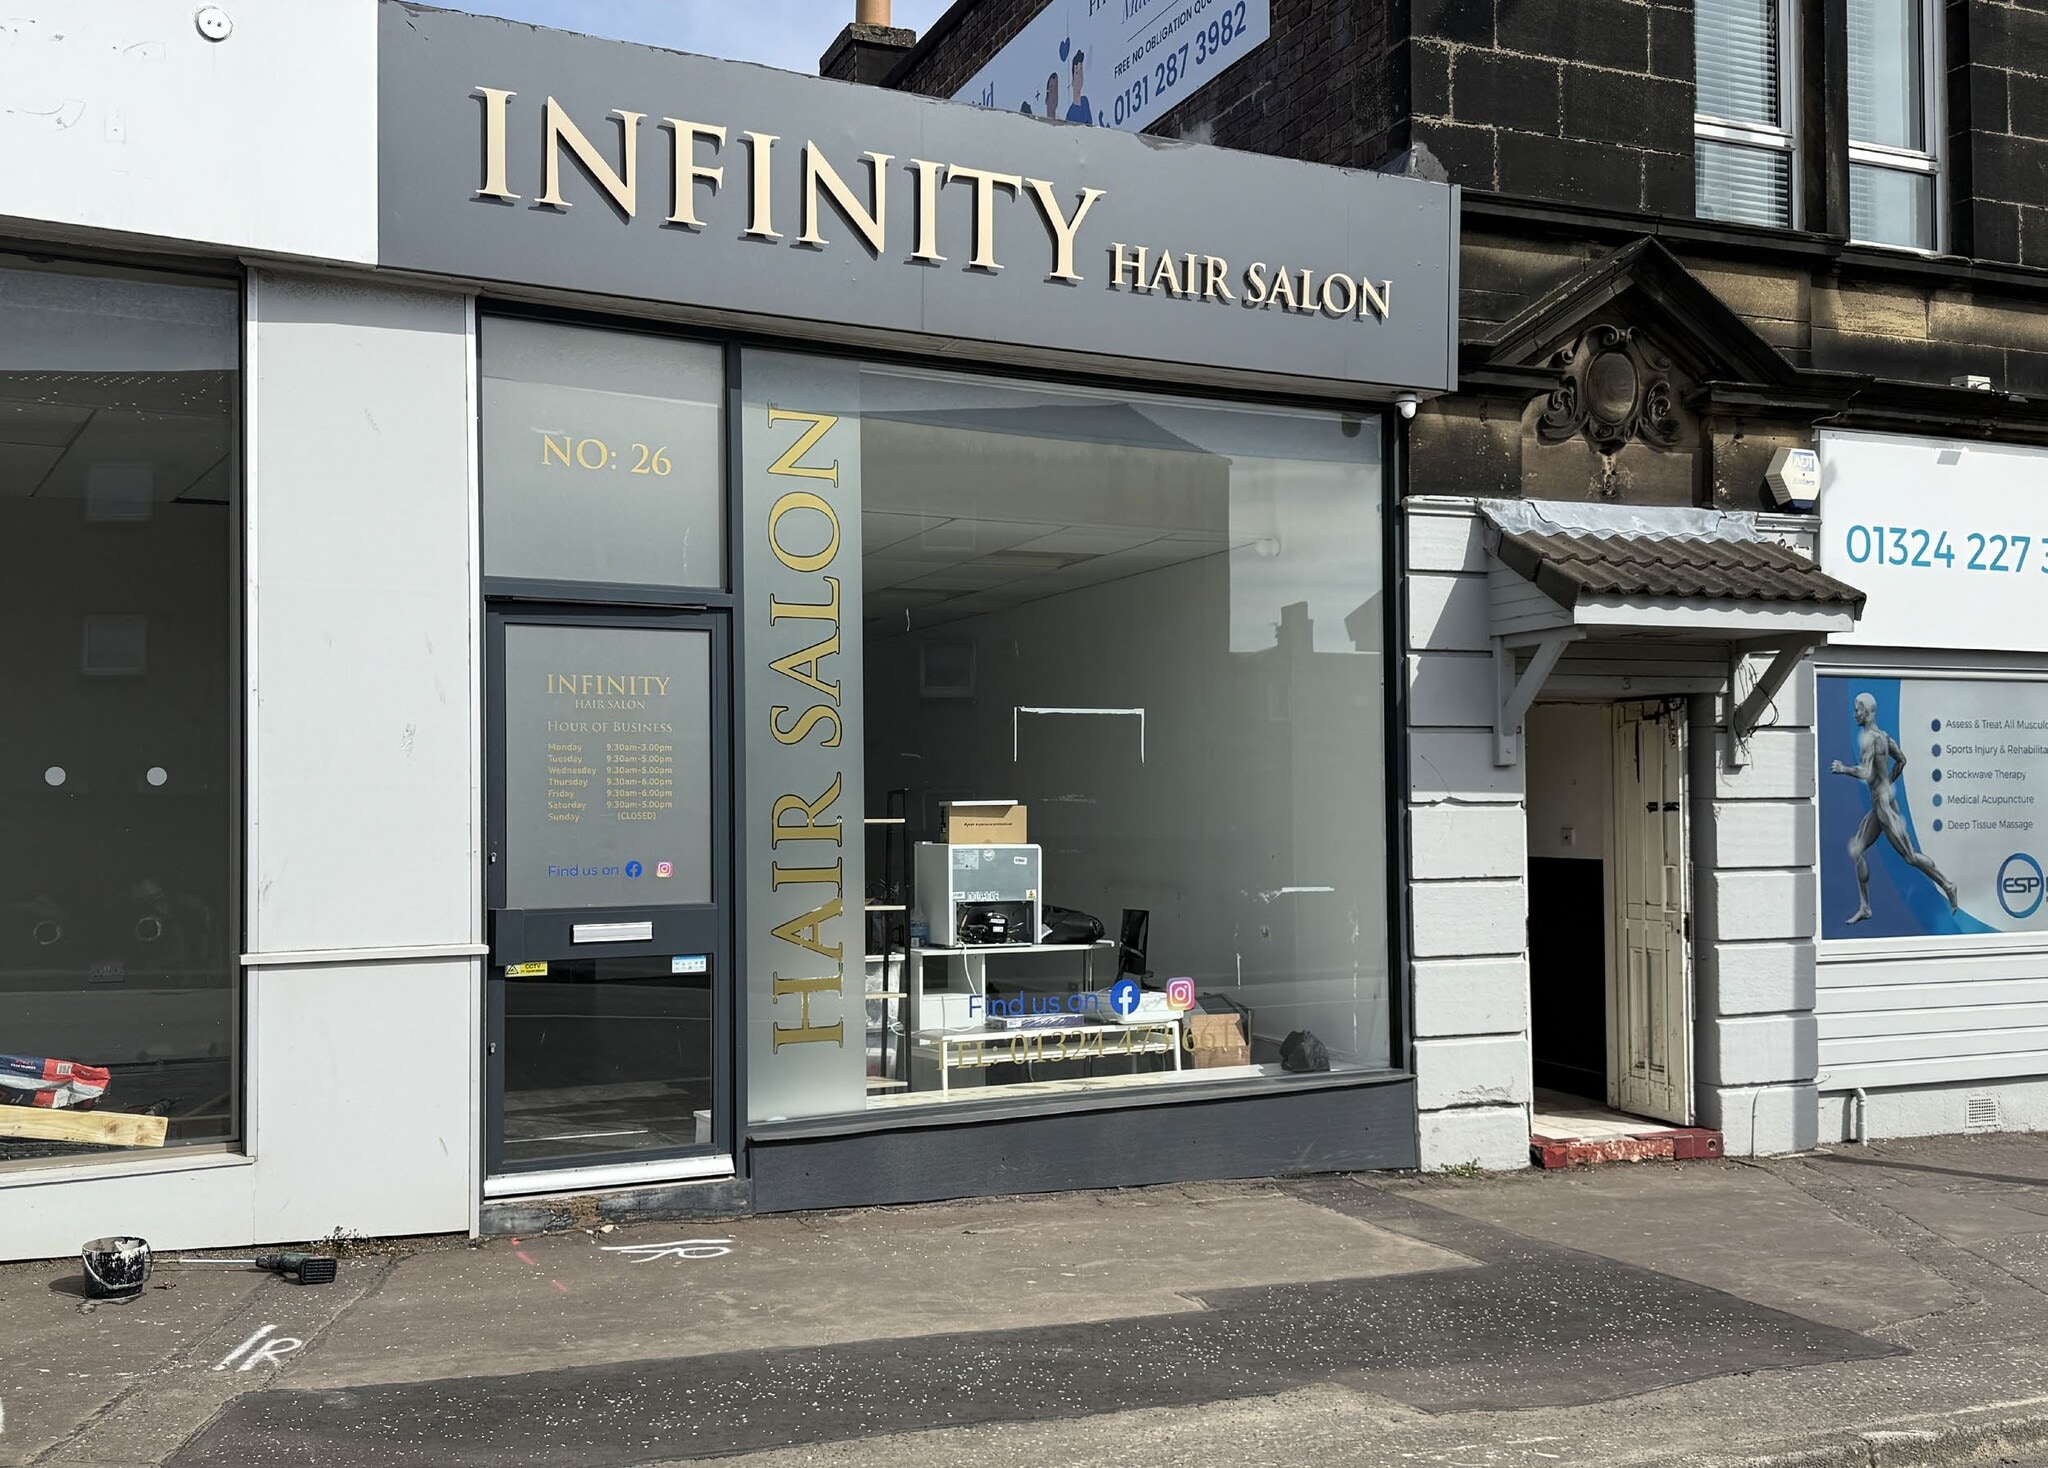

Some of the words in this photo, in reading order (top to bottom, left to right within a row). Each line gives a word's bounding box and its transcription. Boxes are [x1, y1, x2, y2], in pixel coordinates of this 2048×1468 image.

[1114, 56, 1130, 79] FREE
[1132, 46, 1144, 65] NO
[1145, 7, 1192, 53] OBLIGATION
[1114, 74, 1148, 126] 0131
[1155, 43, 1189, 97] 287
[1195, 0, 1246, 65] 3982
[474, 85, 1107, 281] INFINITY
[1110, 242, 1236, 301] HAIR
[1247, 261, 1393, 320] SALON
[541, 434, 617, 470] NO:
[630, 443, 672, 476] 26
[1846, 525, 1955, 568] 01324
[1966, 532, 2031, 573] 227
[767, 401, 842, 748] SALON
[547, 674, 670, 696] INFINITY
[575, 700, 605, 709] HAIR
[607, 700, 646, 710] SALON
[1946, 719, 1972, 729] Assess
[1975, 719, 1980, 729] &
[1982, 719, 2002, 729] Treat
[2004, 719, 2015, 729] All
[547, 743, 582, 753] Monday
[1946, 744, 1973, 756] Sports
[1975, 744, 1998, 756] Injury
[2000, 744, 2005, 754] &
[547, 754, 582, 764] Tuesday
[547, 766, 597, 775] Wednesday
[1946, 769, 1993, 779] Shockwave
[1995, 769, 2026, 781] Therapy
[548, 778, 588, 787] Thursday
[548, 789, 575, 799] Friday
[1947, 794, 1980, 804] Medical
[1981, 795, 2035, 806] Acupuncture
[547, 801, 587, 811] Saturday
[547, 813, 580, 822] Sunday
[617, 811, 656, 821] (CLOSED)
[1947, 820, 1970, 831] Deep
[1972, 820, 1998, 829] Tissue
[1999, 820, 2034, 831] Massage
[547, 864, 579, 877] Find
[582, 867, 598, 877] us
[602, 866, 619, 876] on
[2003, 877, 2040, 893] ESP
[770, 771, 844, 1055] HAIR
[968, 991, 1024, 1018] Find
[1033, 996, 1060, 1013] us
[1067, 992, 1098, 1011] on
[1009, 1027, 1106, 1065] 01324
[1116, 1025, 1171, 1056] 473
[1181, 1019, 1236, 1053] 661
